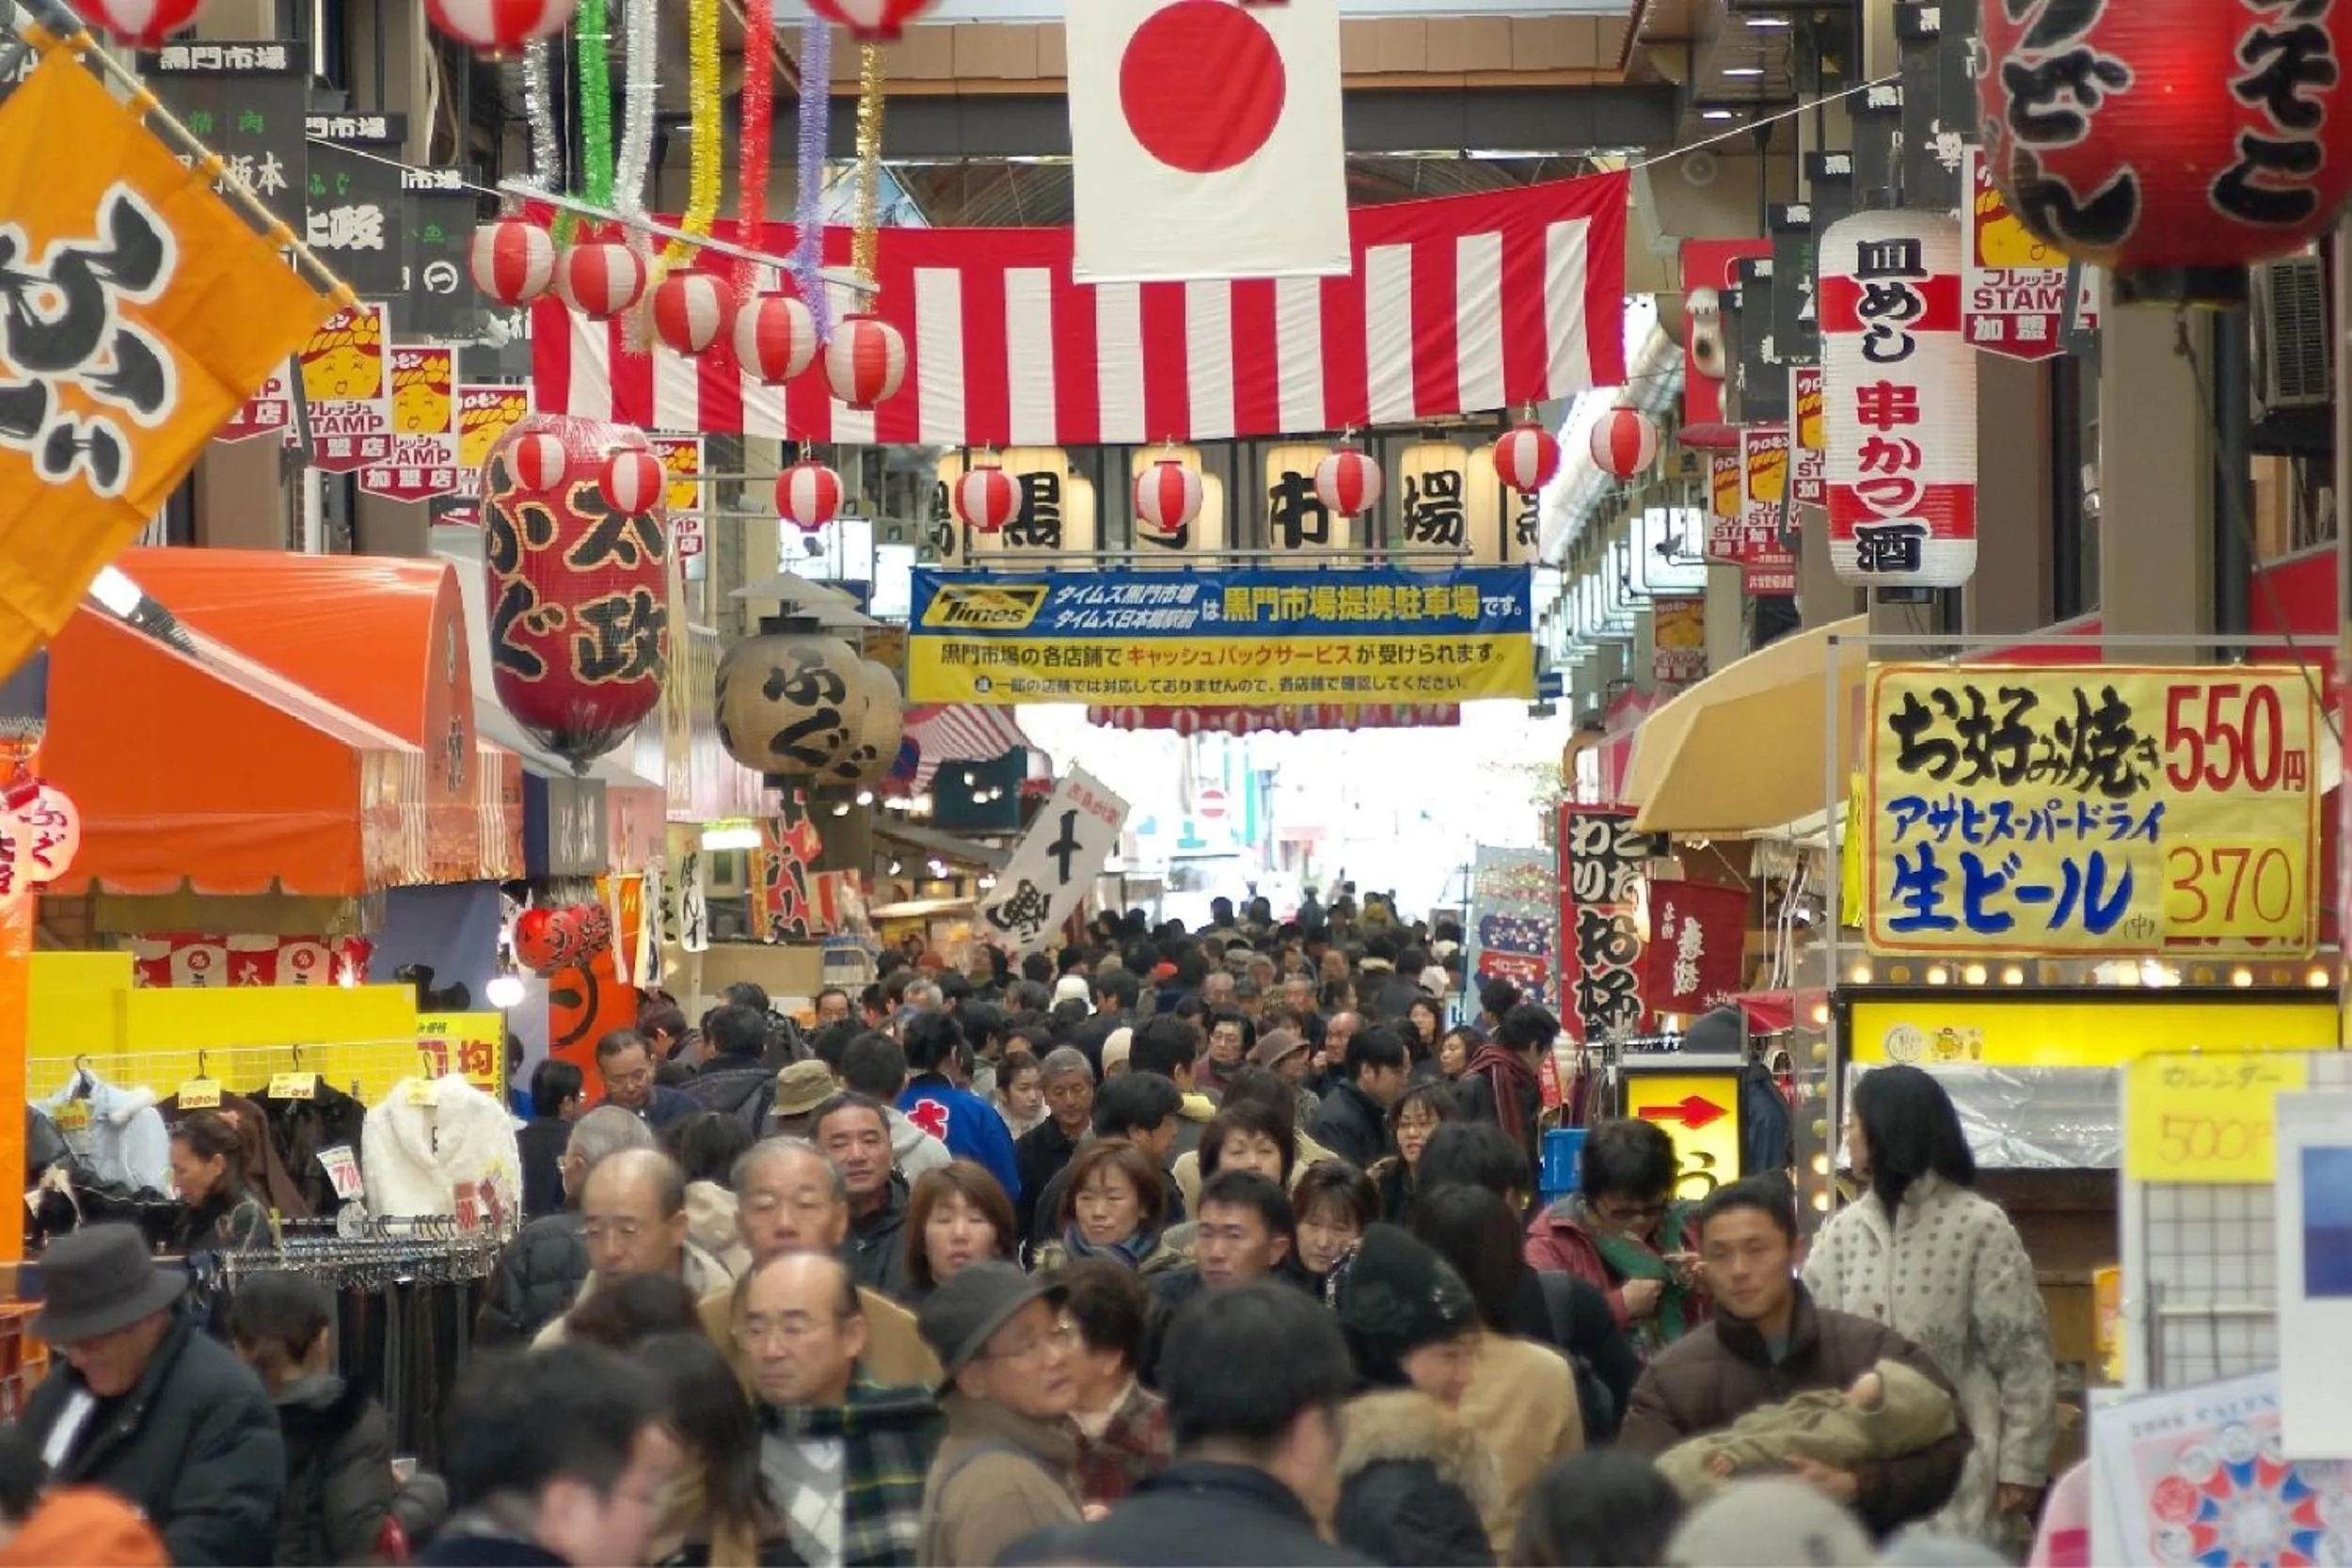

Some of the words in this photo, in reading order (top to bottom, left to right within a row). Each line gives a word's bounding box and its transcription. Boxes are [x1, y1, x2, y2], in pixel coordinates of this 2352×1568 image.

[160, 45, 286, 71] 黒門市場
[306, 117, 387, 138] 門市場
[402, 169, 462, 189] 市場
[310, 417, 385, 434] TAMP
[943, 601, 1027, 623] Times
[1888, 685, 2162, 799] お好み焼き
[2164, 683, 2308, 793] 550円
[1885, 841, 2134, 935] 生ビール
[2169, 845, 2293, 924] 370
